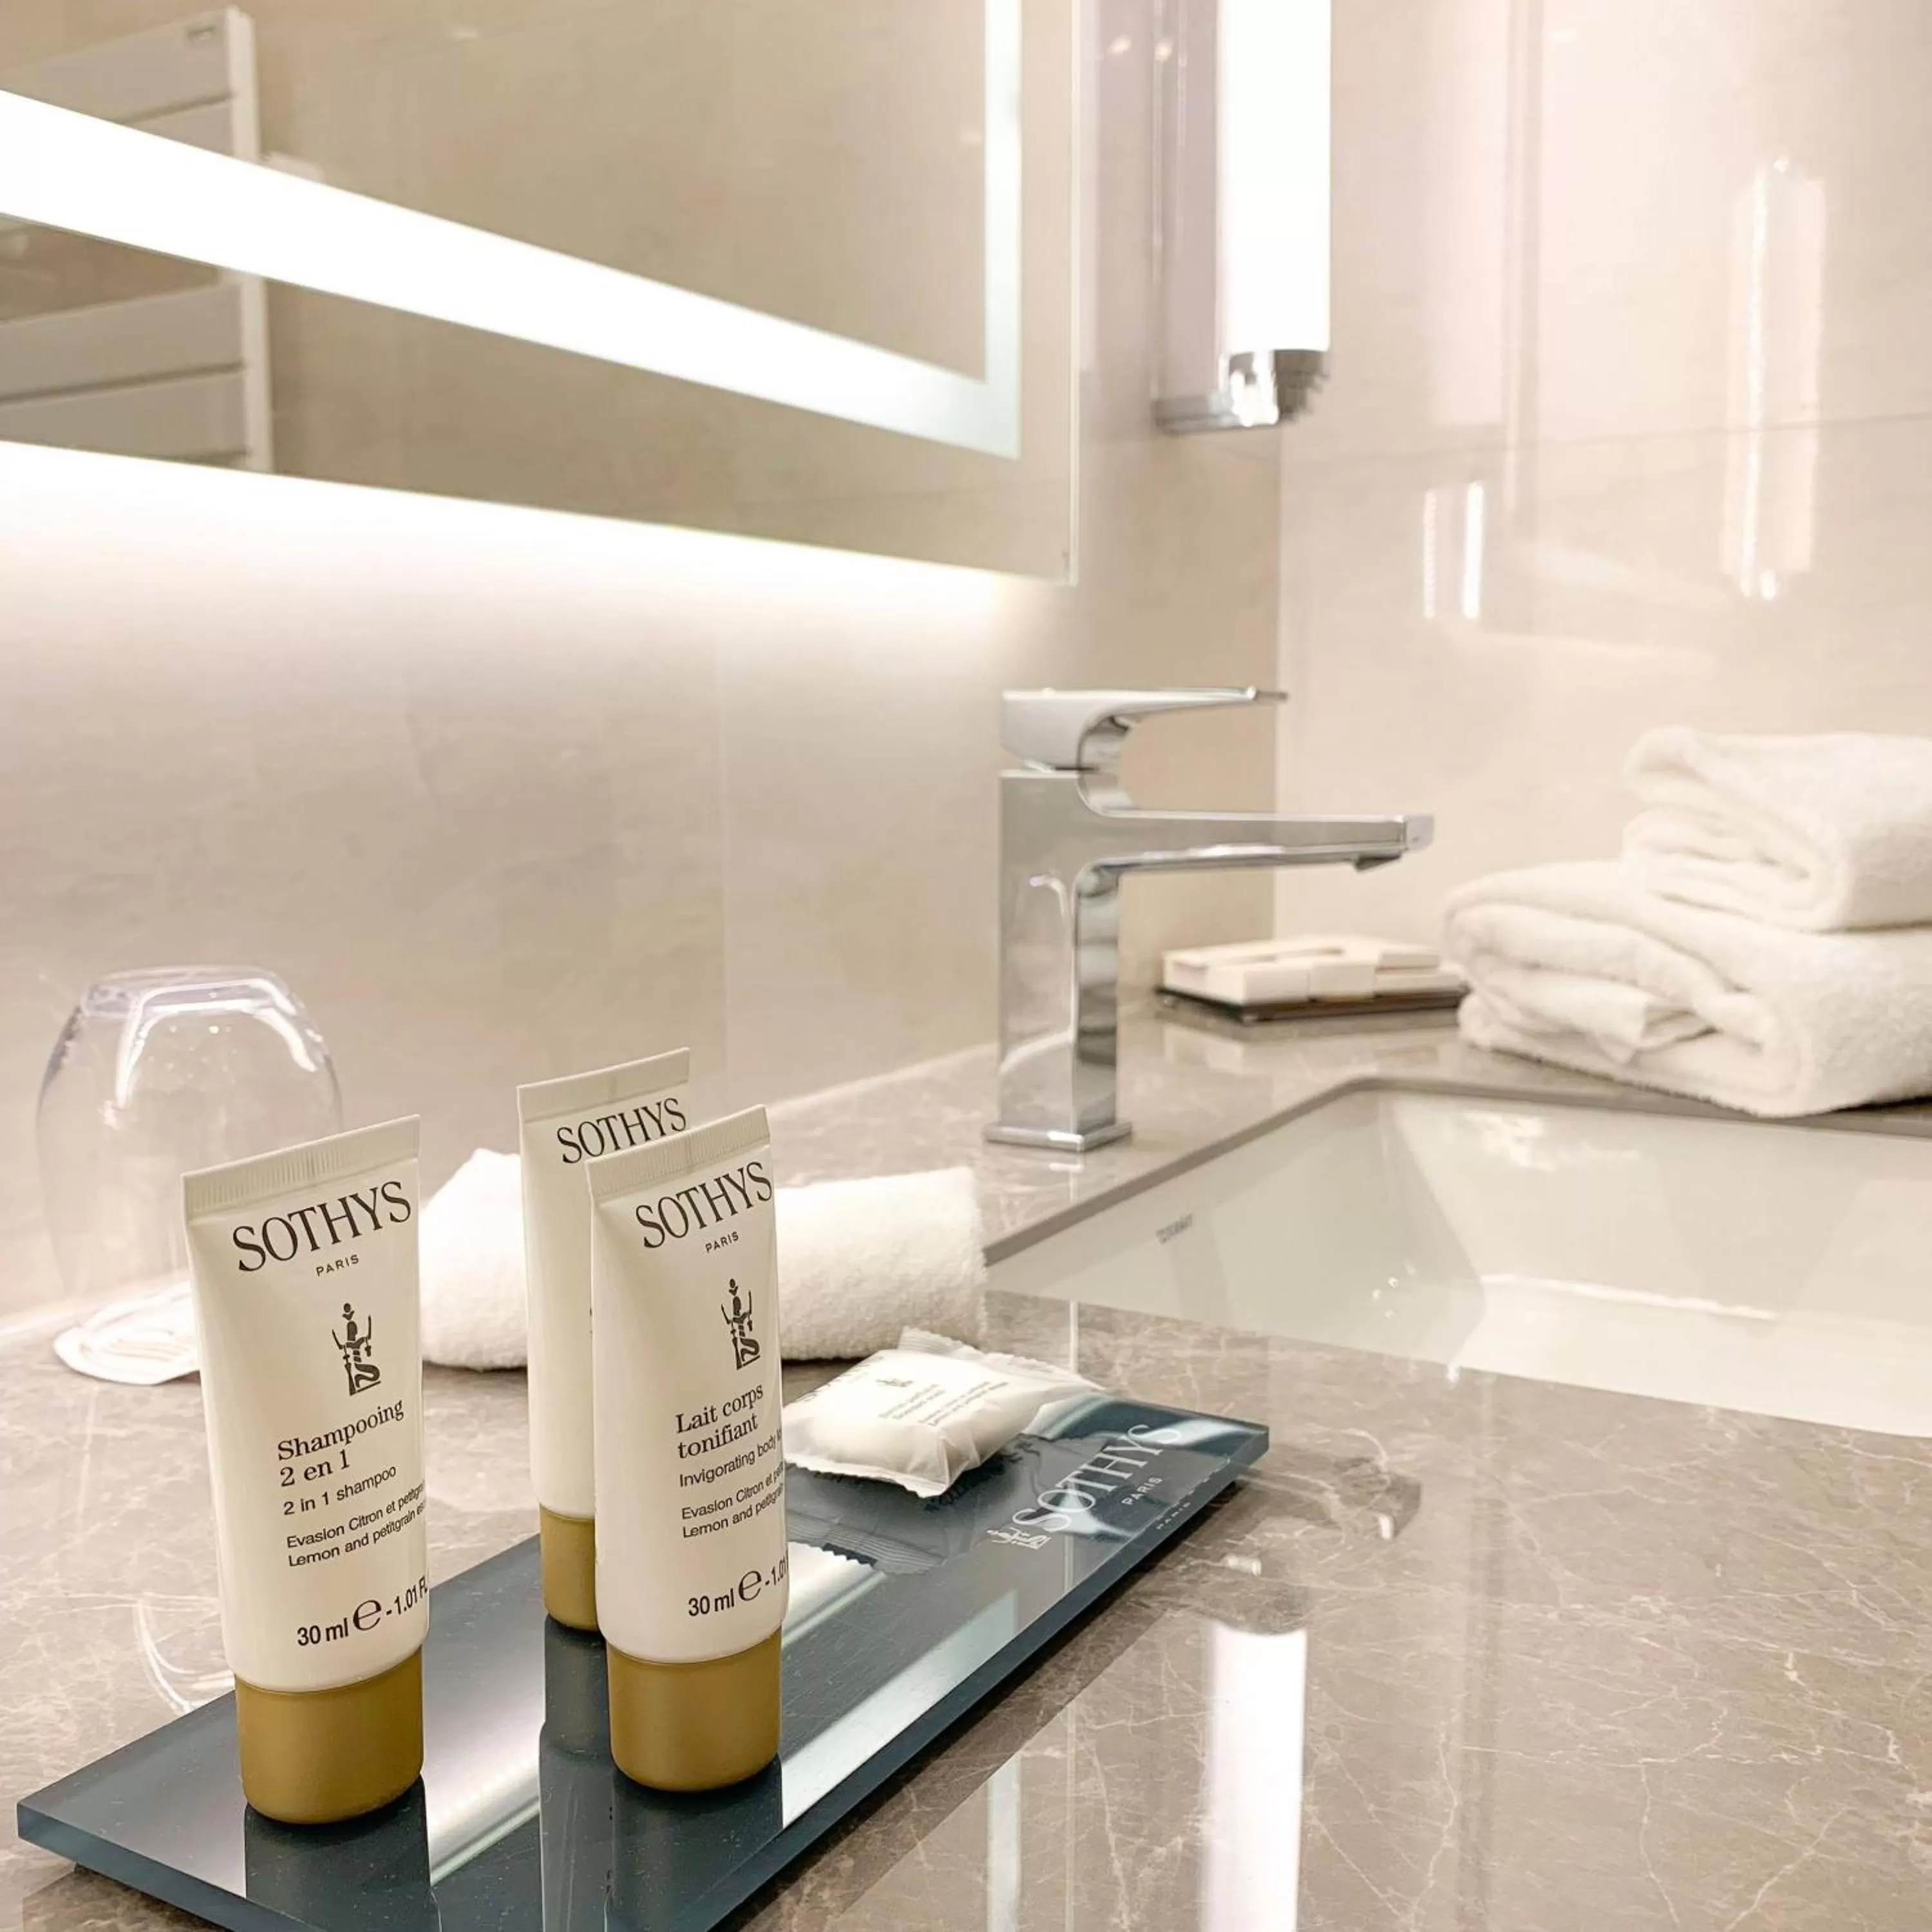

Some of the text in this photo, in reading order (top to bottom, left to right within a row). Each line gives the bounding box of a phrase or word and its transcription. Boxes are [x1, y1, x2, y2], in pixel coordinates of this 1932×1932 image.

[556, 1097, 687, 1164] SOTHYS
[232, 1181, 412, 1272] SOTHYS
[635, 1161, 773, 1249] SOTHYS
[315, 1253, 360, 1277] PARIS
[705, 1231, 739, 1253] PARIS
[278, 1400, 404, 1461] Shampooing
[675, 1384, 764, 1434] Lait corps
[677, 1412, 759, 1459] tonifiant
[280, 1449, 351, 1487] 2 en 1
[679, 1449, 755, 1488] Invigorating
[757, 1434, 776, 1457] body
[1012, 1424, 1182, 1533] SOTHYS
[283, 1465, 397, 1515] 2 in 1 shampoo
[681, 1495, 733, 1520] Evasion
[736, 1481, 764, 1502] Citron
[765, 1473, 773, 1487] et
[1121, 1476, 1163, 1506] PARIS
[287, 1524, 345, 1549] Evasion
[348, 1508, 384, 1531] Citron
[386, 1501, 396, 1514] et
[288, 1509, 416, 1567] Lemon and petitgrain
[683, 1517, 729, 1539] Lemon
[732, 1504, 753, 1525] and
[688, 1595, 710, 1617] 30
[714, 1588, 735, 1613] ml
[297, 1625, 321, 1647] 30
[325, 1617, 348, 1642] ml
